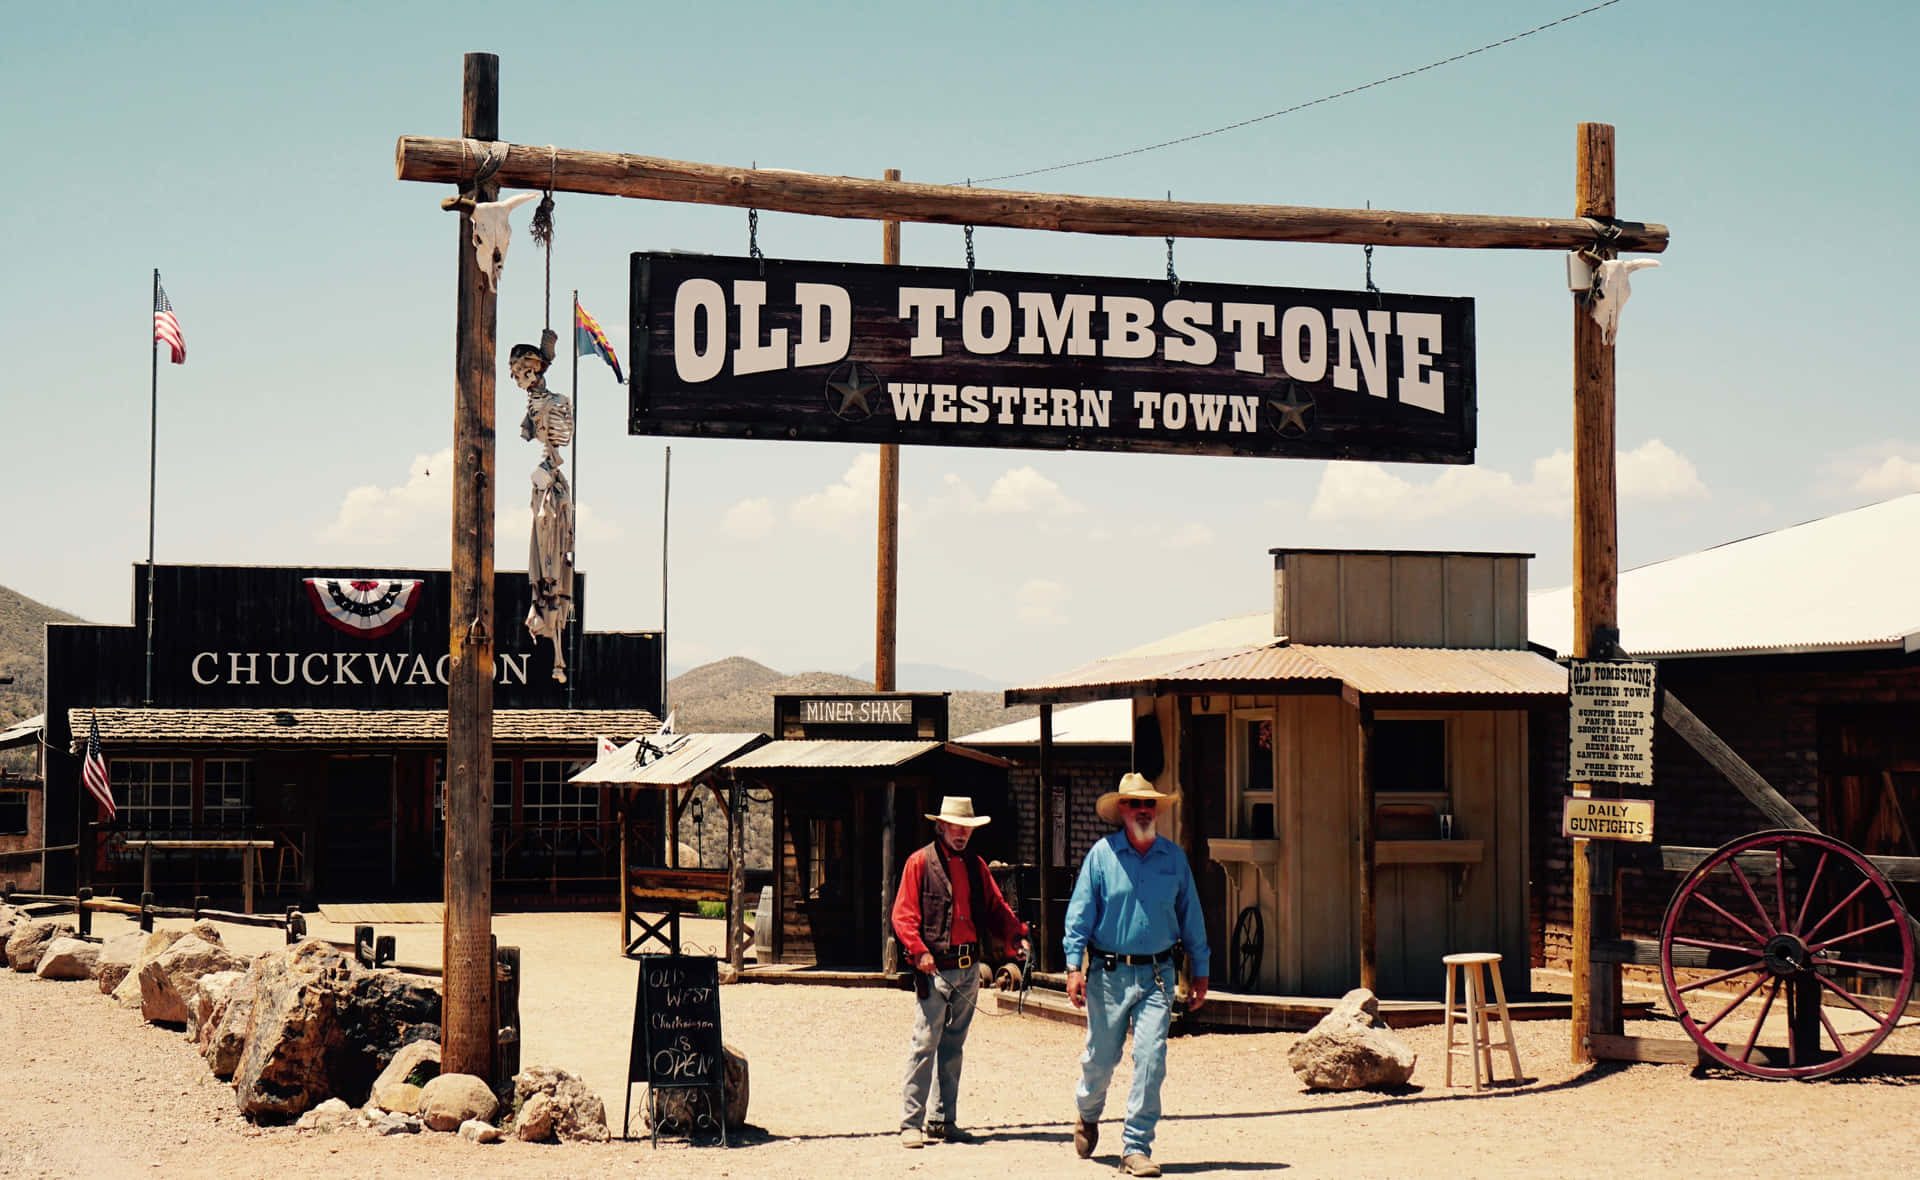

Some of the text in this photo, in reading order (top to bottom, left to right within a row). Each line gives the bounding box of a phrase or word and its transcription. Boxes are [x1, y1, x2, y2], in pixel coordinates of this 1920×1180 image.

[674, 278, 1444, 414] OLD TOMBSTONE
[888, 383, 1259, 433] WESTERN TOWN
[192, 652, 532, 686] CHUCKWAN
[1574, 664, 1651, 687] OLD TOMBSTONE
[1575, 686, 1650, 698] WESTERN TOWN
[1593, 699, 1609, 707] GIFT
[807, 702, 903, 723] MINER SHAK
[1578, 709, 1644, 719] GUNFIGHT SHOWS
[1585, 718, 1599, 726] PAN
[1619, 719, 1637, 727] GOLD
[1611, 728, 1644, 736] GALLERY
[1585, 743, 1636, 752] RESTAURANT
[1576, 751, 1610, 760] CANTINA
[1622, 753, 1643, 761] MORE
[1608, 764, 1635, 772] ENTRY
[1588, 804, 1629, 817] DAILY
[1571, 817, 1644, 834] GUNFIGHTS
[650, 968, 685, 988] OLD
[667, 987, 712, 1007] WEST
[654, 1048, 714, 1081] OPEN
